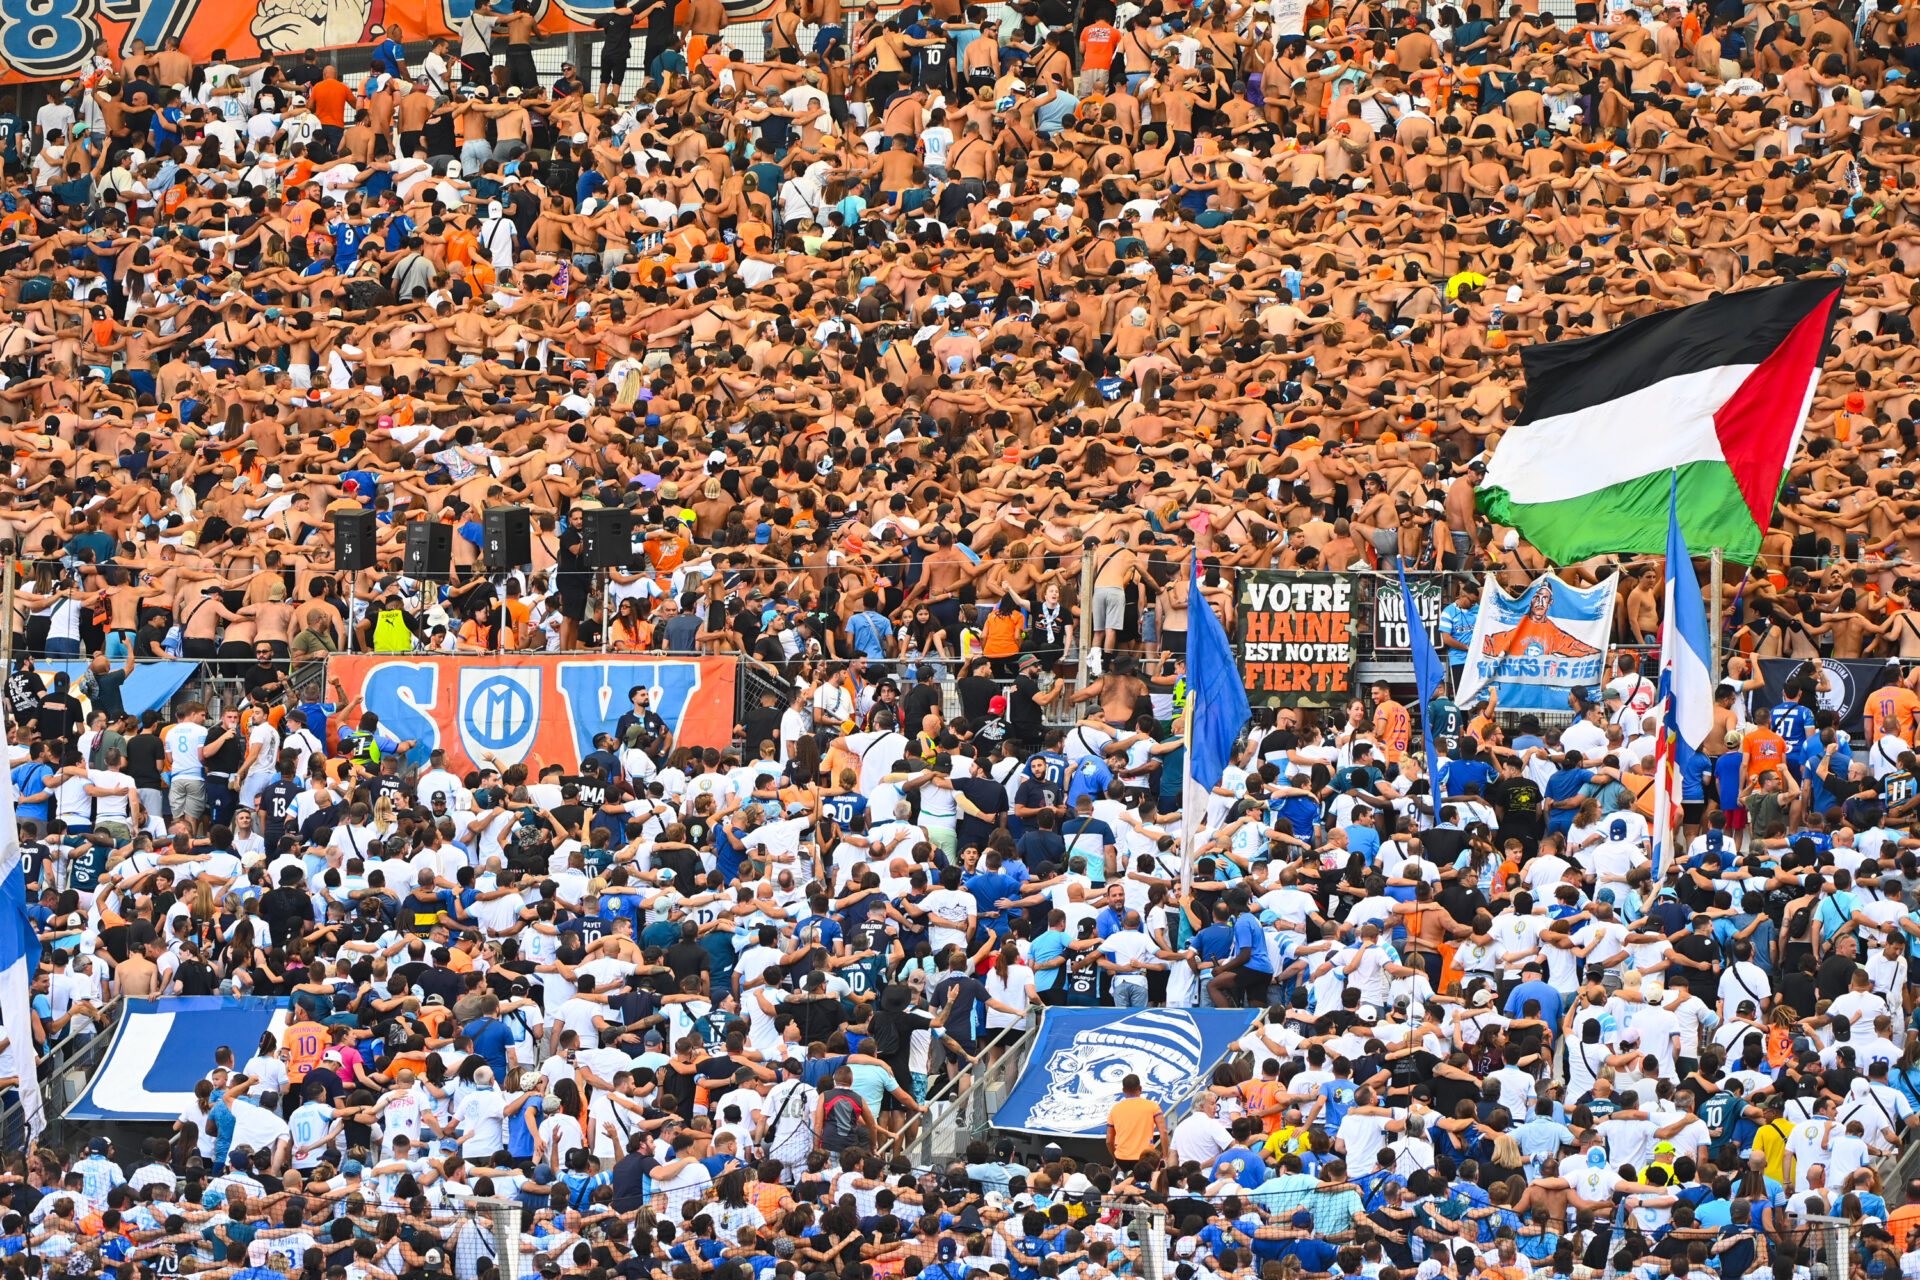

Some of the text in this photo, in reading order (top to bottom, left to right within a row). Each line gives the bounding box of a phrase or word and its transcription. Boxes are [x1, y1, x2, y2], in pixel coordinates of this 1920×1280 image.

[926, 50, 940, 65] 10
[224, 101, 238, 117] 10
[928, 138, 941, 153] 10
[345, 229, 354, 245] 9
[345, 543, 352, 554] 5
[491, 540, 498, 551] 8
[588, 540, 593, 551] 7
[412, 551, 420, 561] 6
[1247, 583, 1351, 612] VOTRE
[1246, 612, 1350, 643] HAINE
[1380, 620, 1438, 648] TOT
[1245, 643, 1349, 662] EST NOTRE
[1245, 663, 1348, 692] FIERTE
[1820, 659, 1850, 680] ALESTINA
[1880, 699, 1895, 717] 10
[1447, 713, 1457, 733] 9
[178, 735, 188, 753] 8
[273, 797, 286, 818] 13
[834, 802, 853, 823] 10
[584, 864, 598, 880] 10
[582, 921, 602, 929] PAYET
[532, 935, 542, 955] 9
[582, 929, 602, 946] 10
[865, 930, 876, 948] 5
[847, 971, 866, 992] 10
[298, 1035, 317, 1056] 10
[1705, 1106, 1723, 1128] 10
[296, 1121, 312, 1143] 10
